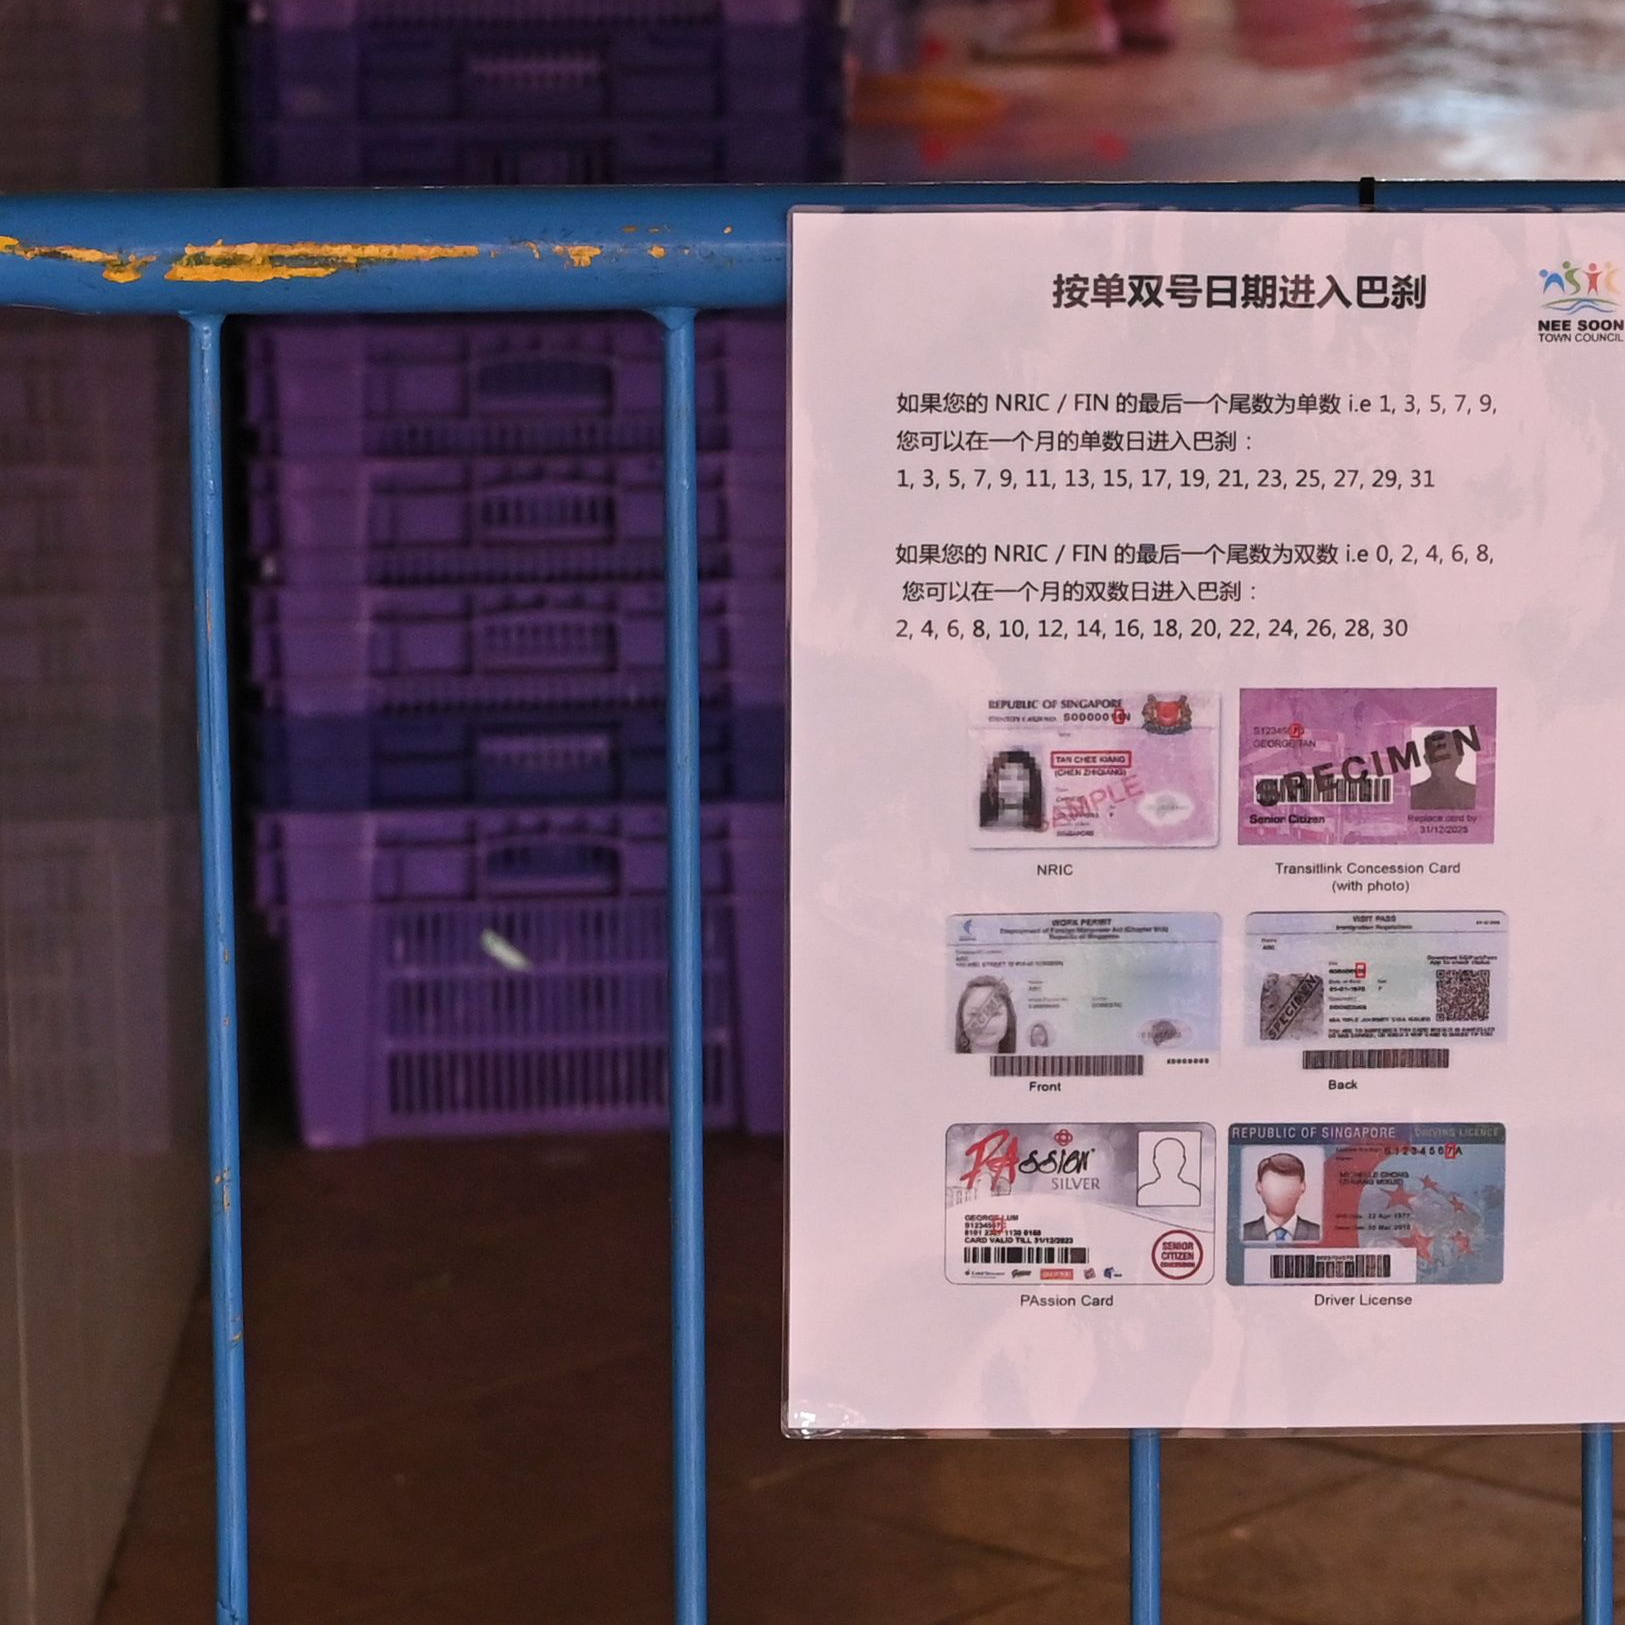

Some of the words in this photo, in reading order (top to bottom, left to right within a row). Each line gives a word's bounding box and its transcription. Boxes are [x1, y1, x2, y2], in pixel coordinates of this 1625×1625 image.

[1052, 272, 1427, 310] 按单双号日期进入巴刹
[1538, 319, 1572, 332] NEE
[1577, 319, 1625, 332] SOON
[1538, 332, 1572, 343] TOWN
[1574, 332, 1624, 343] COUNCIL
[896, 392, 989, 414] 如果您的
[995, 393, 1050, 412] NRIC
[1056, 393, 1068, 414] /
[1074, 393, 1109, 412] FIN
[1116, 392, 1341, 415] 的最后一个尾数为单数
[1349, 393, 1372, 413] i.e
[1380, 394, 1396, 415] 1,
[1404, 394, 1421, 415] 3,
[1430, 394, 1446, 415] 5,
[1454, 394, 1471, 415] 7,
[1479, 393, 1497, 415] 9,
[897, 469, 914, 490] 1,
[922, 468, 940, 490] 3,
[949, 468, 966, 490] 5,
[974, 468, 992, 490] 7,
[999, 468, 1017, 490] 9,
[1026, 469, 1056, 490] 11,
[1065, 468, 1095, 490] 13,
[1103, 468, 1133, 490] 15,
[1141, 468, 1172, 490] 17,
[1180, 468, 1210, 490] 19,
[1217, 468, 1249, 490] 21,
[1257, 468, 1288, 490] 23,
[1295, 469, 1326, 491] 25,
[1333, 468, 1364, 490] 27,
[1371, 469, 1402, 490] 29,
[1410, 469, 1435, 488] 31
[895, 543, 987, 565] 如果您的
[994, 543, 1048, 563] NRIC
[1055, 544, 1066, 565] /
[1072, 544, 1107, 563] FIN
[1114, 542, 1339, 565] 的最后一个尾数为双数
[1346, 543, 1369, 563] i.e
[1376, 544, 1393, 565] 0,
[1401, 544, 1418, 565] 2,
[1425, 544, 1443, 565] 4,
[1451, 544, 1468, 565] 6,
[1476, 543, 1494, 565] 8,
[1255, 725, 1482, 807] SPECIMEN
[1036, 863, 1073, 876] NRIC
[1274, 862, 1343, 875] Transitlink
[1346, 862, 1425, 875] Concession
[1428, 861, 1461, 874] Card
[1331, 880, 1363, 894] (with
[1367, 879, 1410, 894] photo)
[1029, 1080, 1062, 1092] Front
[1328, 1079, 1358, 1090] Back
[1231, 1126, 1298, 1139] REPUBLIC
[1301, 1126, 1317, 1139] OF
[1321, 1125, 1396, 1139] SINGAPORE
[1051, 1177, 1101, 1190] SILVER
[1020, 1294, 1076, 1307] PAssion
[1080, 1294, 1114, 1307] Card
[1314, 1293, 1356, 1307] Driver
[1359, 1293, 1413, 1306] License
